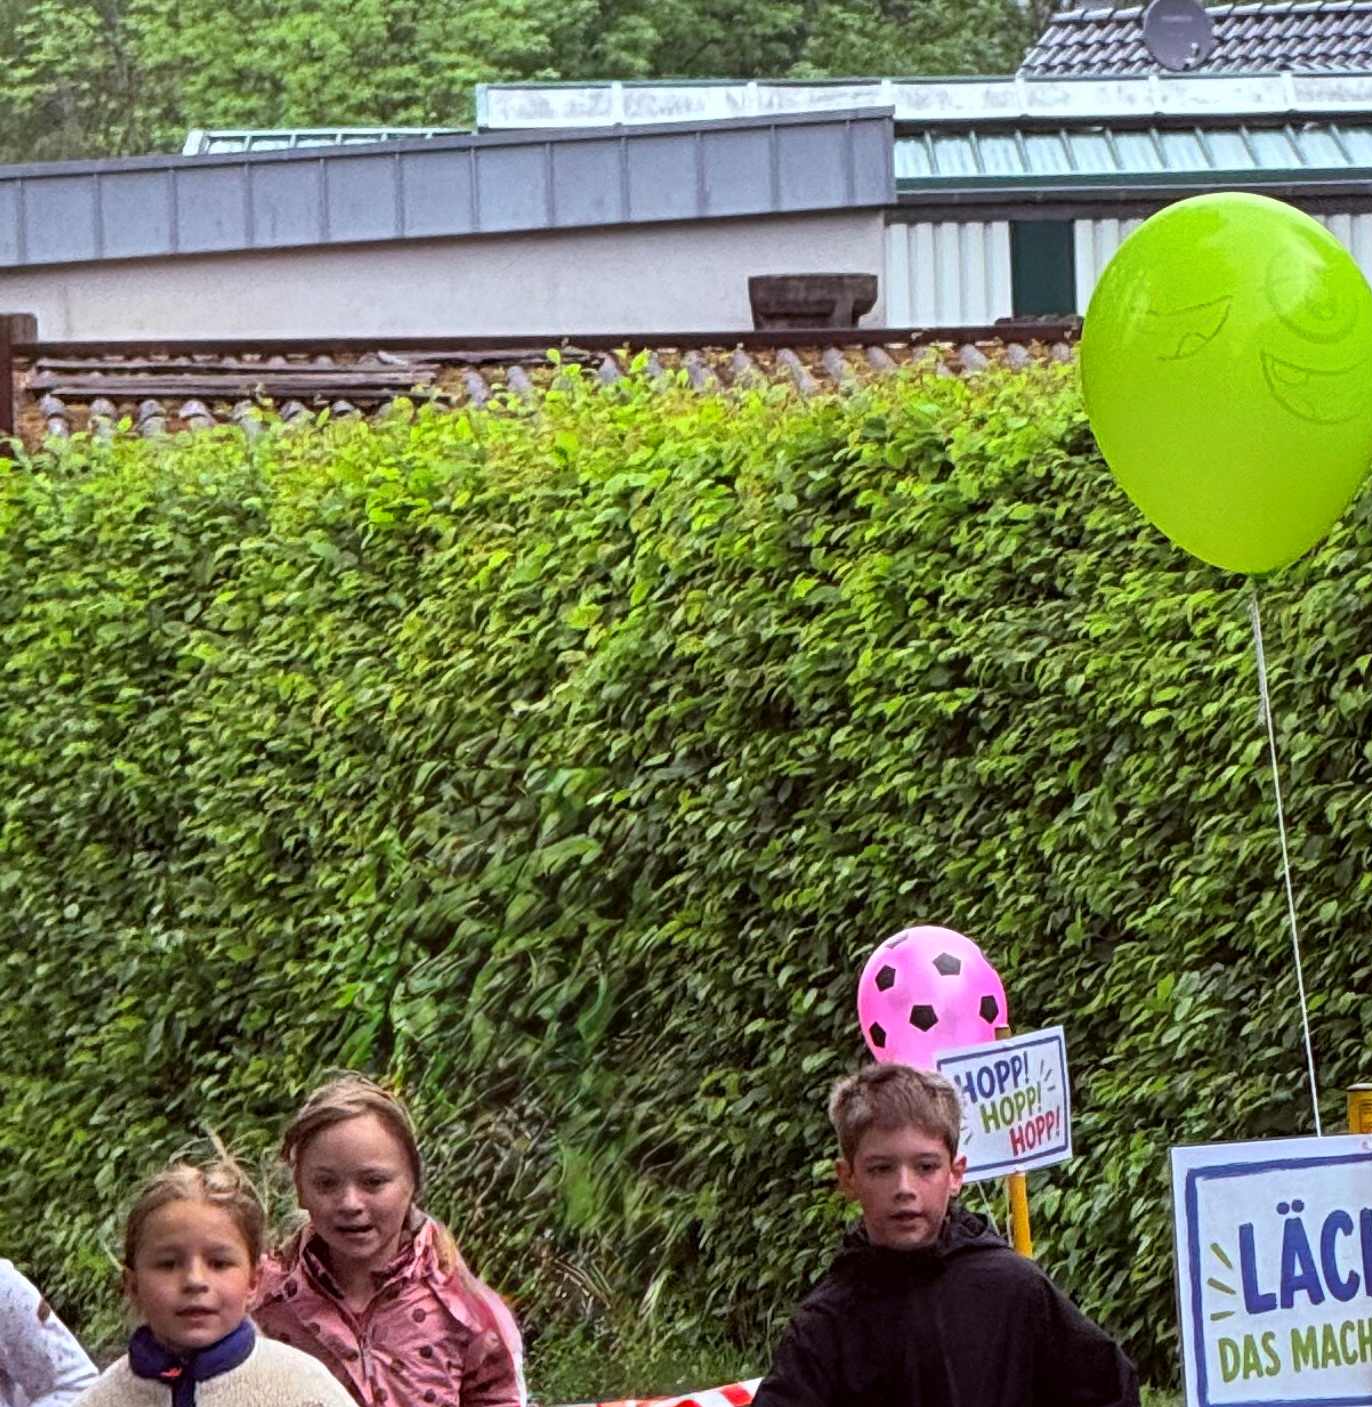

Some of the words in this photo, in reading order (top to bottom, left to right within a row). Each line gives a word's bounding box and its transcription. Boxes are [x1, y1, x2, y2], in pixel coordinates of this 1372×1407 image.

[954, 1051, 1030, 1104] HOPP!
[980, 1081, 1042, 1134] HOPP!
[1009, 1106, 1061, 1157] HOPP!
[1218, 1331, 1282, 1384] DAS
